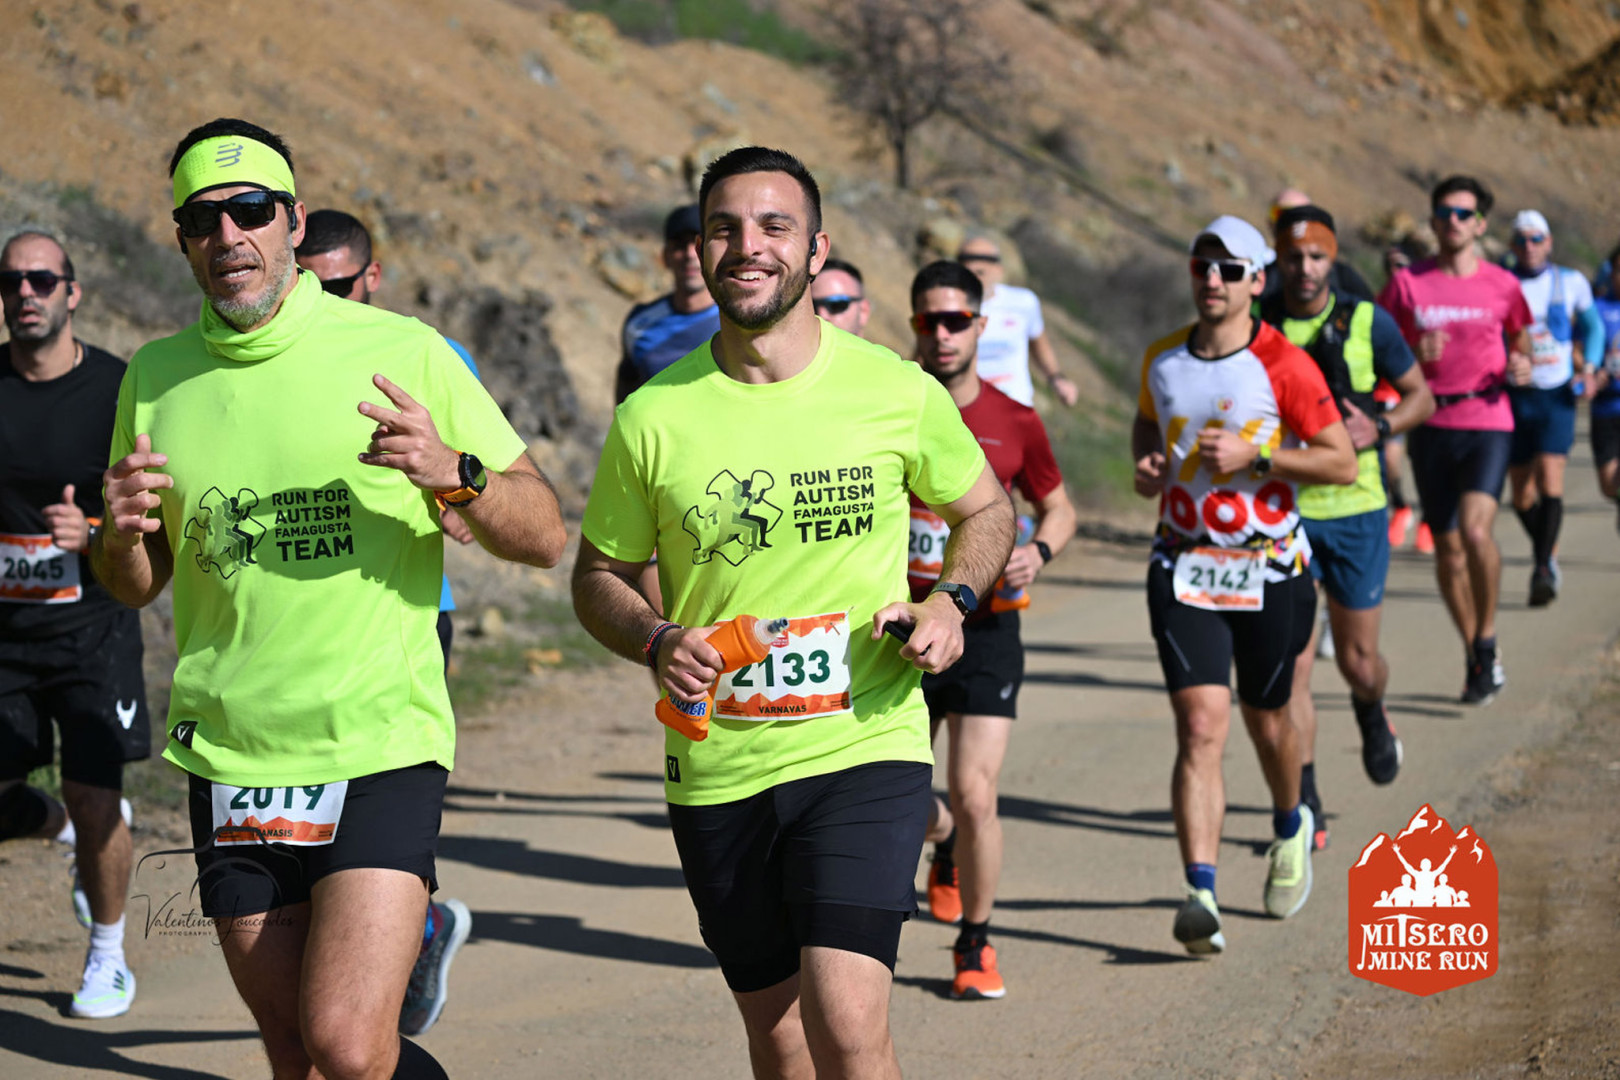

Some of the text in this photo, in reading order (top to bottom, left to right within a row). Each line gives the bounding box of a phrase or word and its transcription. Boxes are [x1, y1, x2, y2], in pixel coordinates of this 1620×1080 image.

[790, 466, 873, 487] RUN FOR
[272, 488, 349, 506] RUN FOR
[793, 483, 875, 506] AUTISM
[275, 504, 351, 525] AUTISM
[794, 502, 875, 520] FAMAGUSTA
[275, 522, 352, 538] FAMAGUSTA
[795, 513, 873, 543] TEAM
[276, 534, 354, 562] TEAM
[4, 557, 64, 580] 2045
[1189, 566, 1251, 591] 2142
[731, 649, 831, 688] 2133
[758, 704, 807, 714] VARNAVAS
[230, 784, 325, 810] 2019
